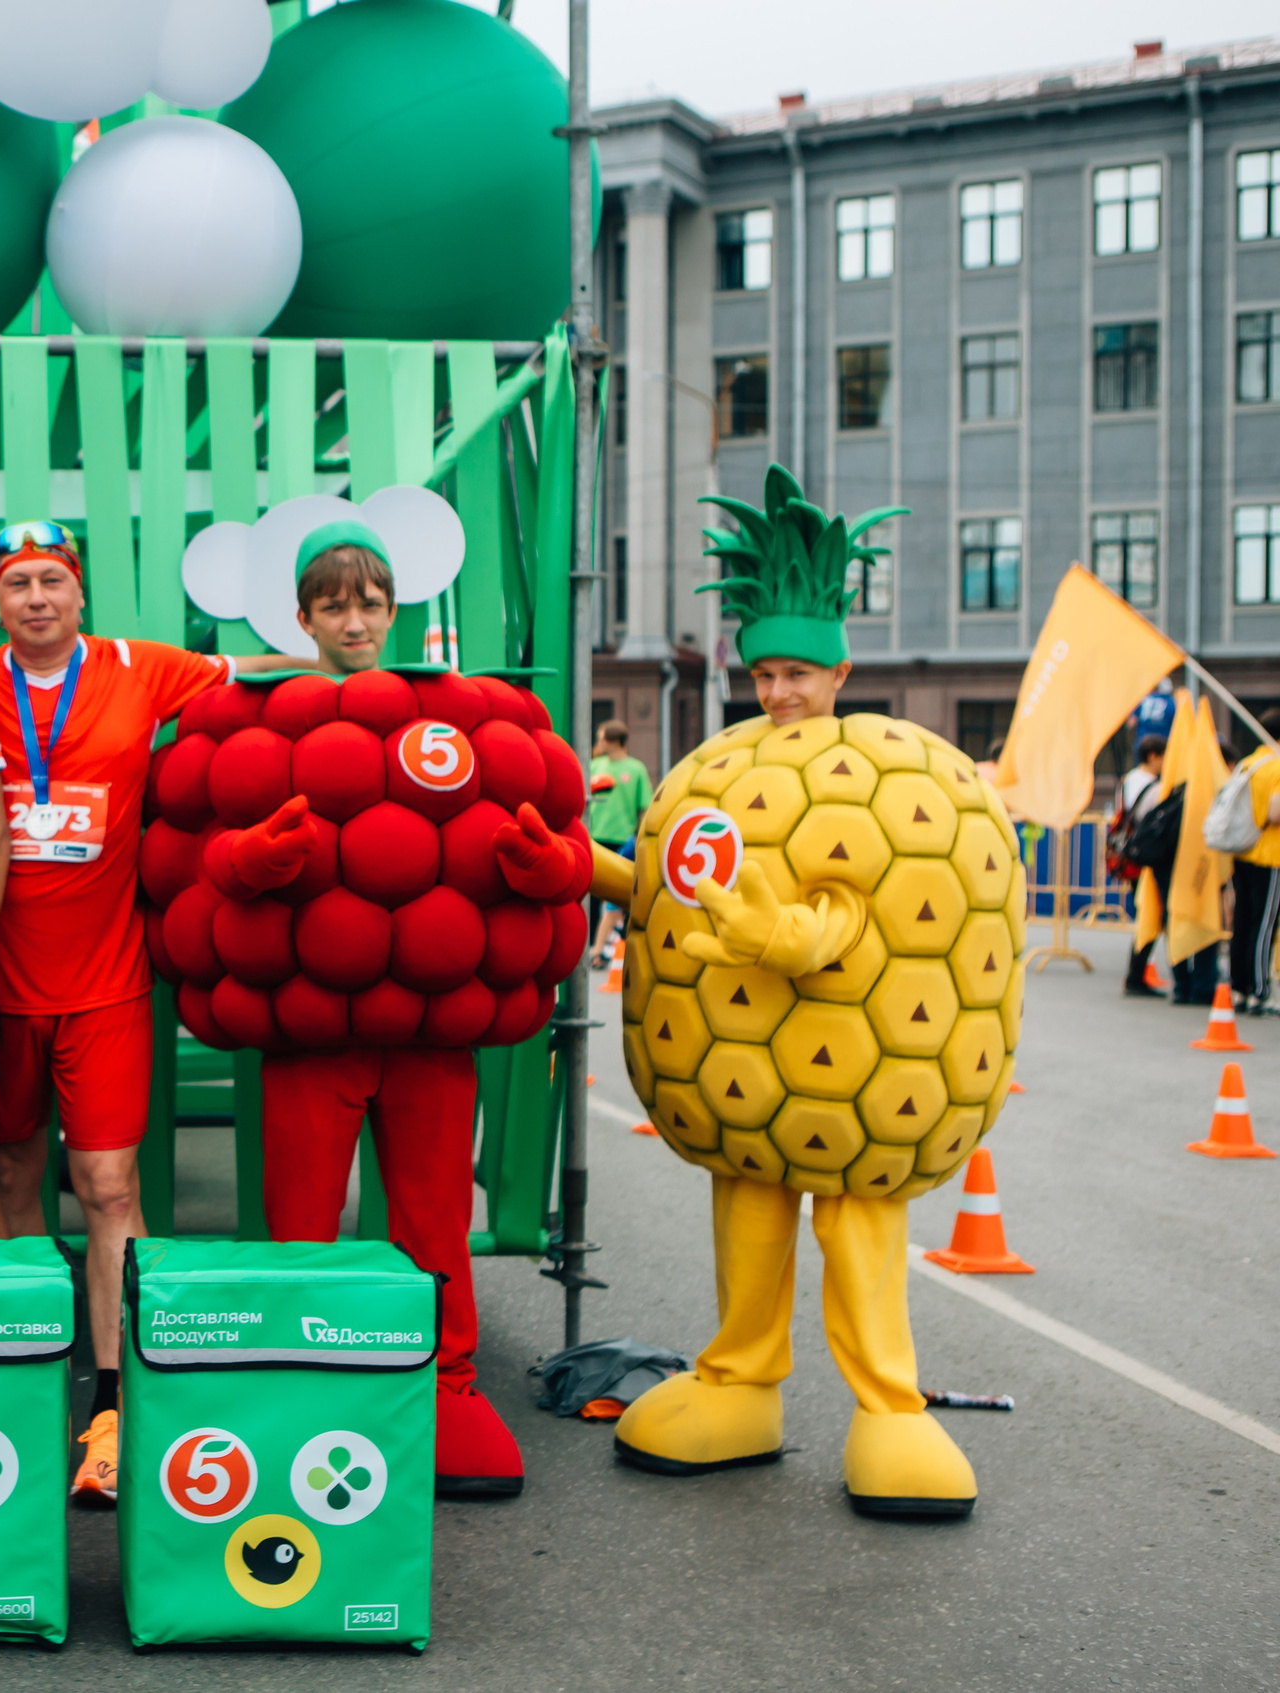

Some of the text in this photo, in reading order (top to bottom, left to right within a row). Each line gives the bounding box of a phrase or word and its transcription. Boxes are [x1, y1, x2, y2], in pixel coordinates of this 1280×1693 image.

[421, 722, 458, 777] 5
[10, 803, 91, 832] 273
[678, 816, 728, 889] 5
[151, 1310, 263, 1327] Доставляем
[152, 1330, 239, 1346] продукты
[184, 1436, 235, 1505] 5
[351, 1611, 392, 1624] 25142
